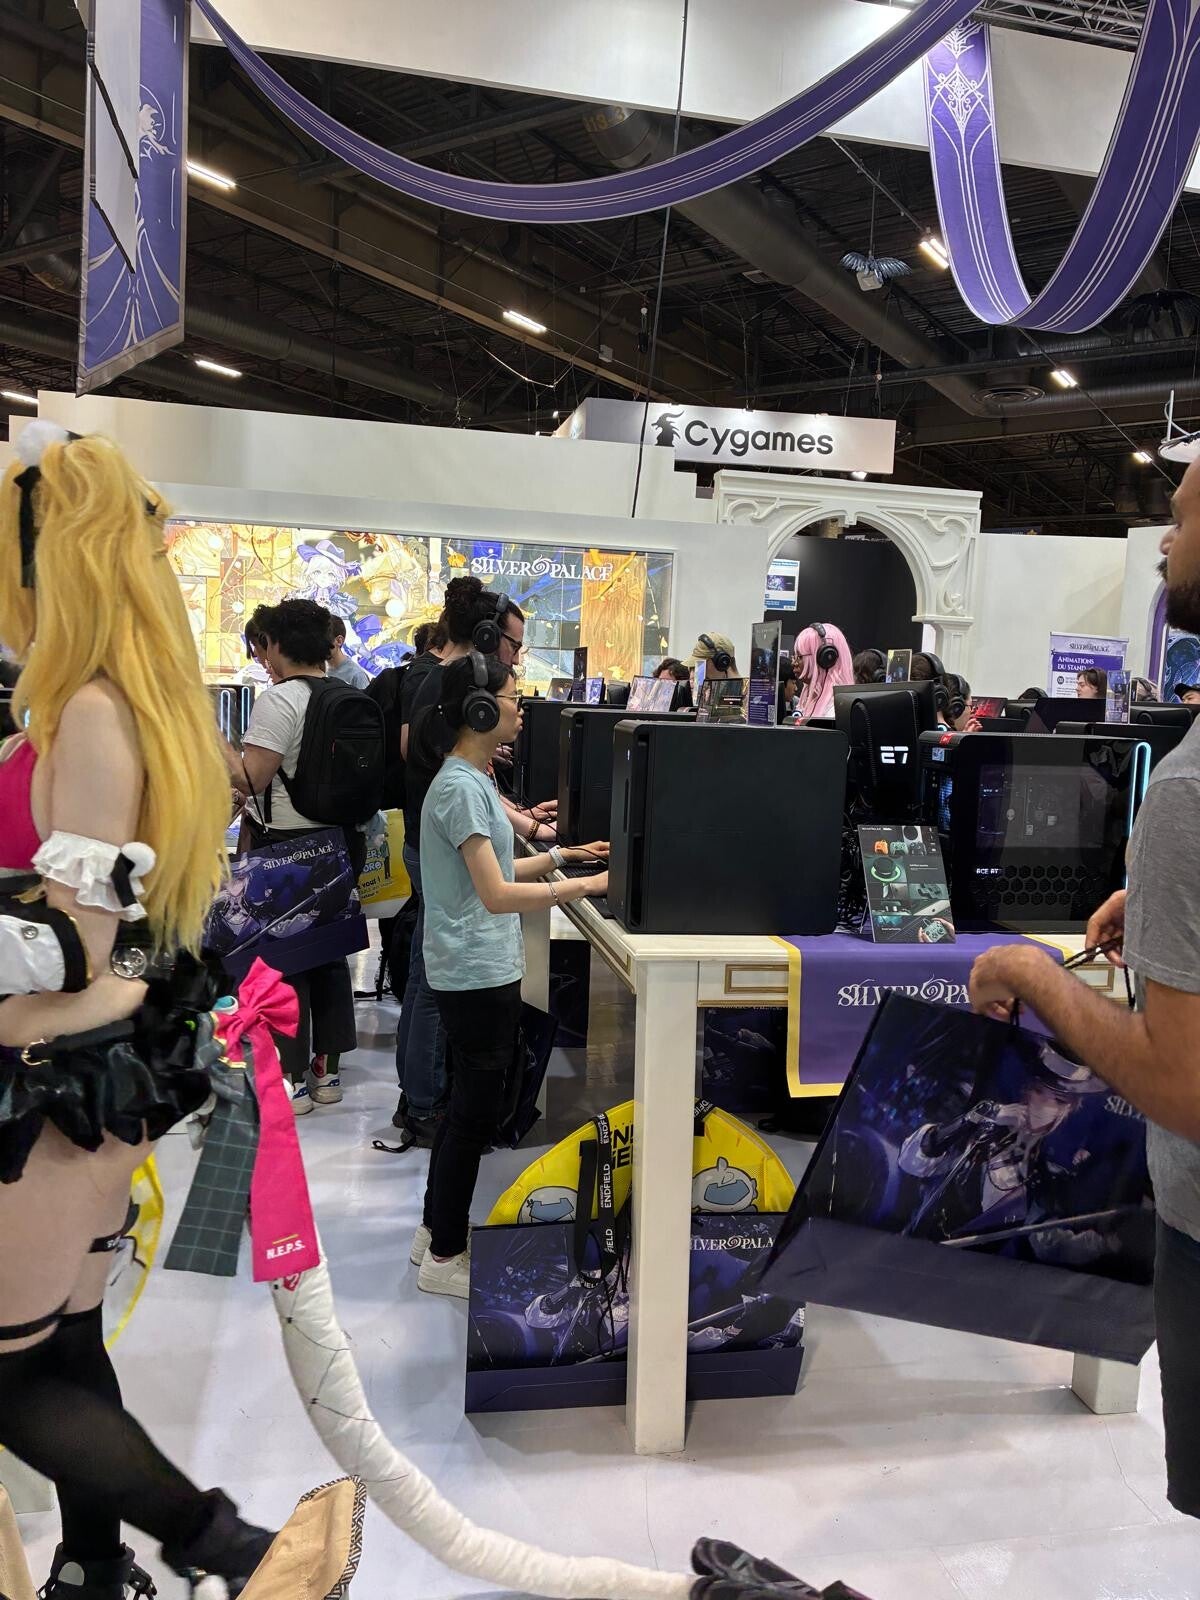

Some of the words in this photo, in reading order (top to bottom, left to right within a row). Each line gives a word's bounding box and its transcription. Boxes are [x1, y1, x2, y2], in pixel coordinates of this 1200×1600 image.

[684, 419, 833, 457] Cygames
[471, 554, 532, 577] SILVER
[549, 562, 613, 581] PALACE
[1057, 656, 1095, 665] ANIMATIONS
[263, 855, 295, 871] SILVER
[302, 840, 335, 860] PALACE
[603, 1163, 612, 1208] ENDFIELD
[691, 1236, 729, 1251] LVER
[741, 1237, 775, 1250] PALA
